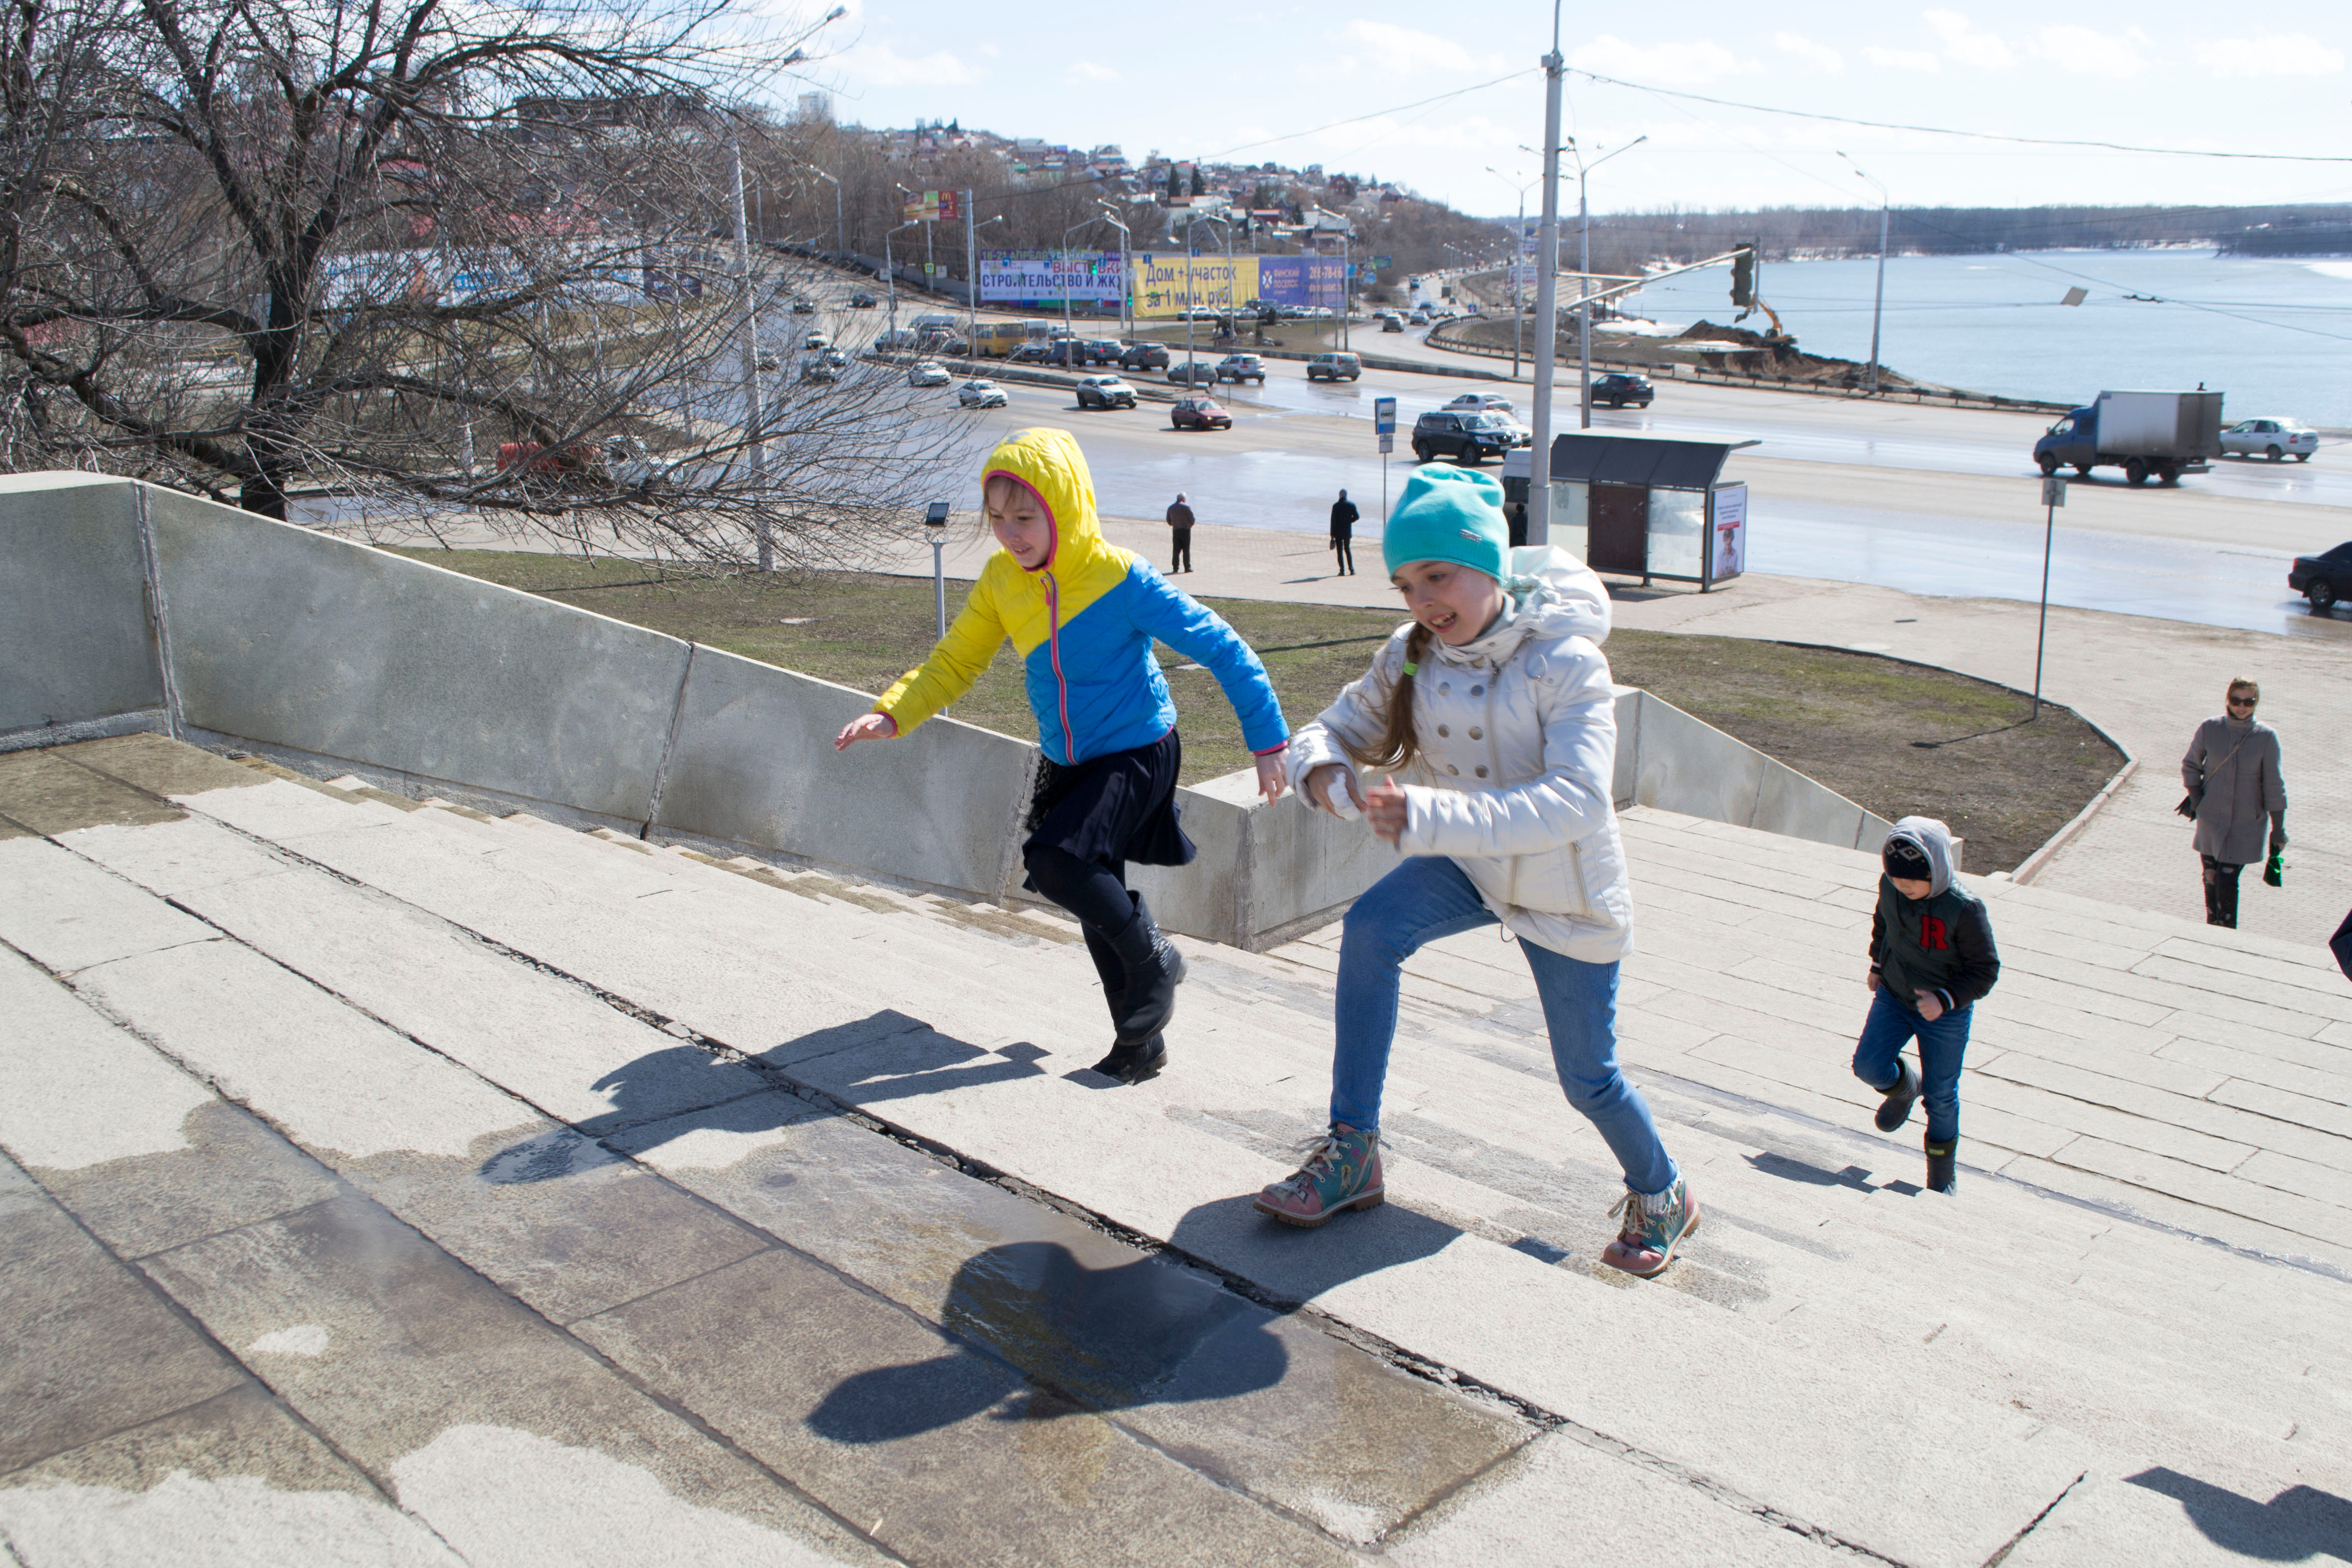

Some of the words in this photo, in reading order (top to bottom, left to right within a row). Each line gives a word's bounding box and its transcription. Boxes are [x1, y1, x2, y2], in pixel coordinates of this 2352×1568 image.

[983, 251, 1007, 259] 18-21
[1053, 262, 1121, 274] ВЫСТВКИ
[1086, 275, 1093, 287] И
[1146, 263, 1174, 287] Дом
[1920, 915, 1948, 951] R
